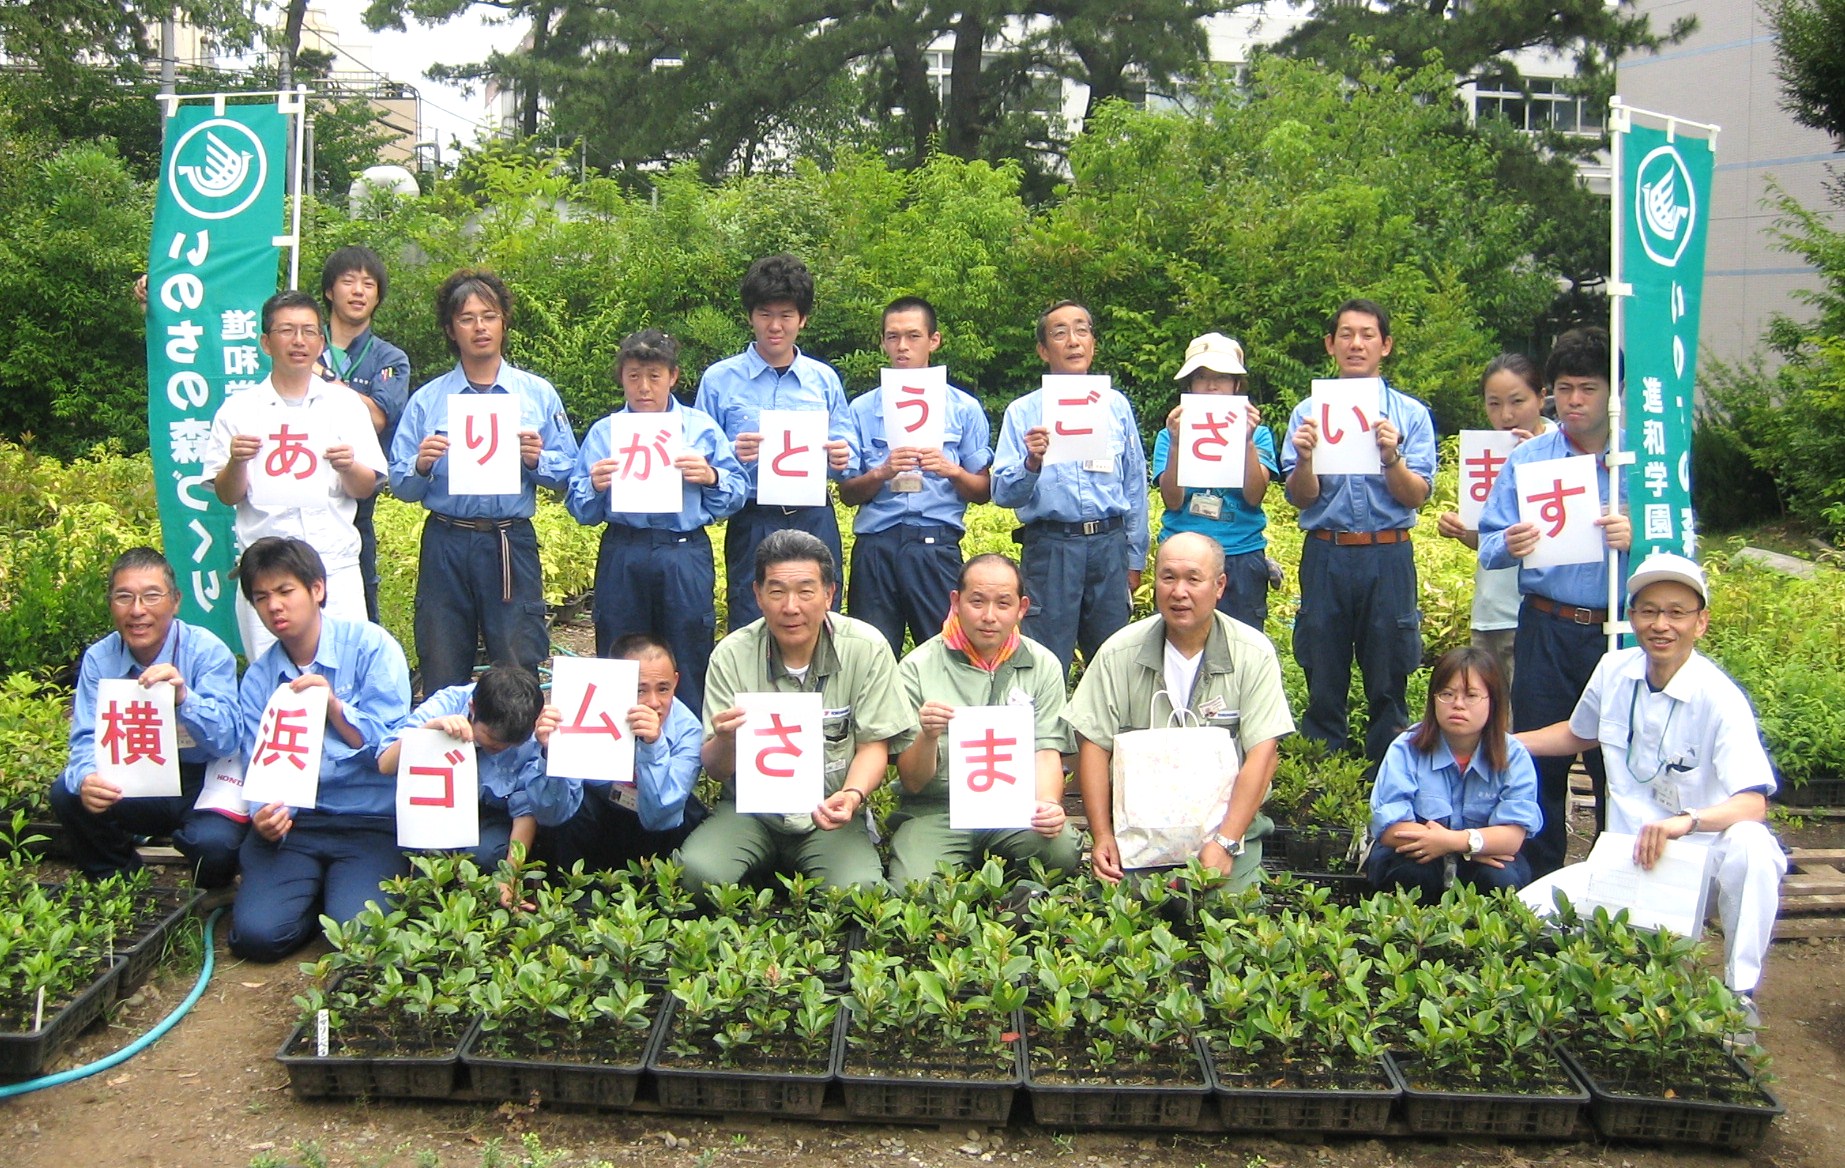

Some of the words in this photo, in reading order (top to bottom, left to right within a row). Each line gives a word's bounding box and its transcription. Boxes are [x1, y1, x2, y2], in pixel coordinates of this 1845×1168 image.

[896, 385, 929, 433] う
[1055, 390, 1101, 436] ご
[1191, 411, 1237, 462] ざ
[1322, 403, 1370, 445] い
[265, 424, 318, 480] あ
[465, 412, 499, 465] り
[619, 429, 671, 481] が
[771, 430, 809, 478] と
[1465, 448, 1508, 502] ま
[1526, 478, 1585, 538] す
[101, 700, 166, 766] 横
[253, 707, 309, 770] 浜
[559, 682, 622, 741] ム
[754, 713, 803, 778] さ
[960, 728, 1017, 793] ま
[409, 749, 466, 808] ゴ
